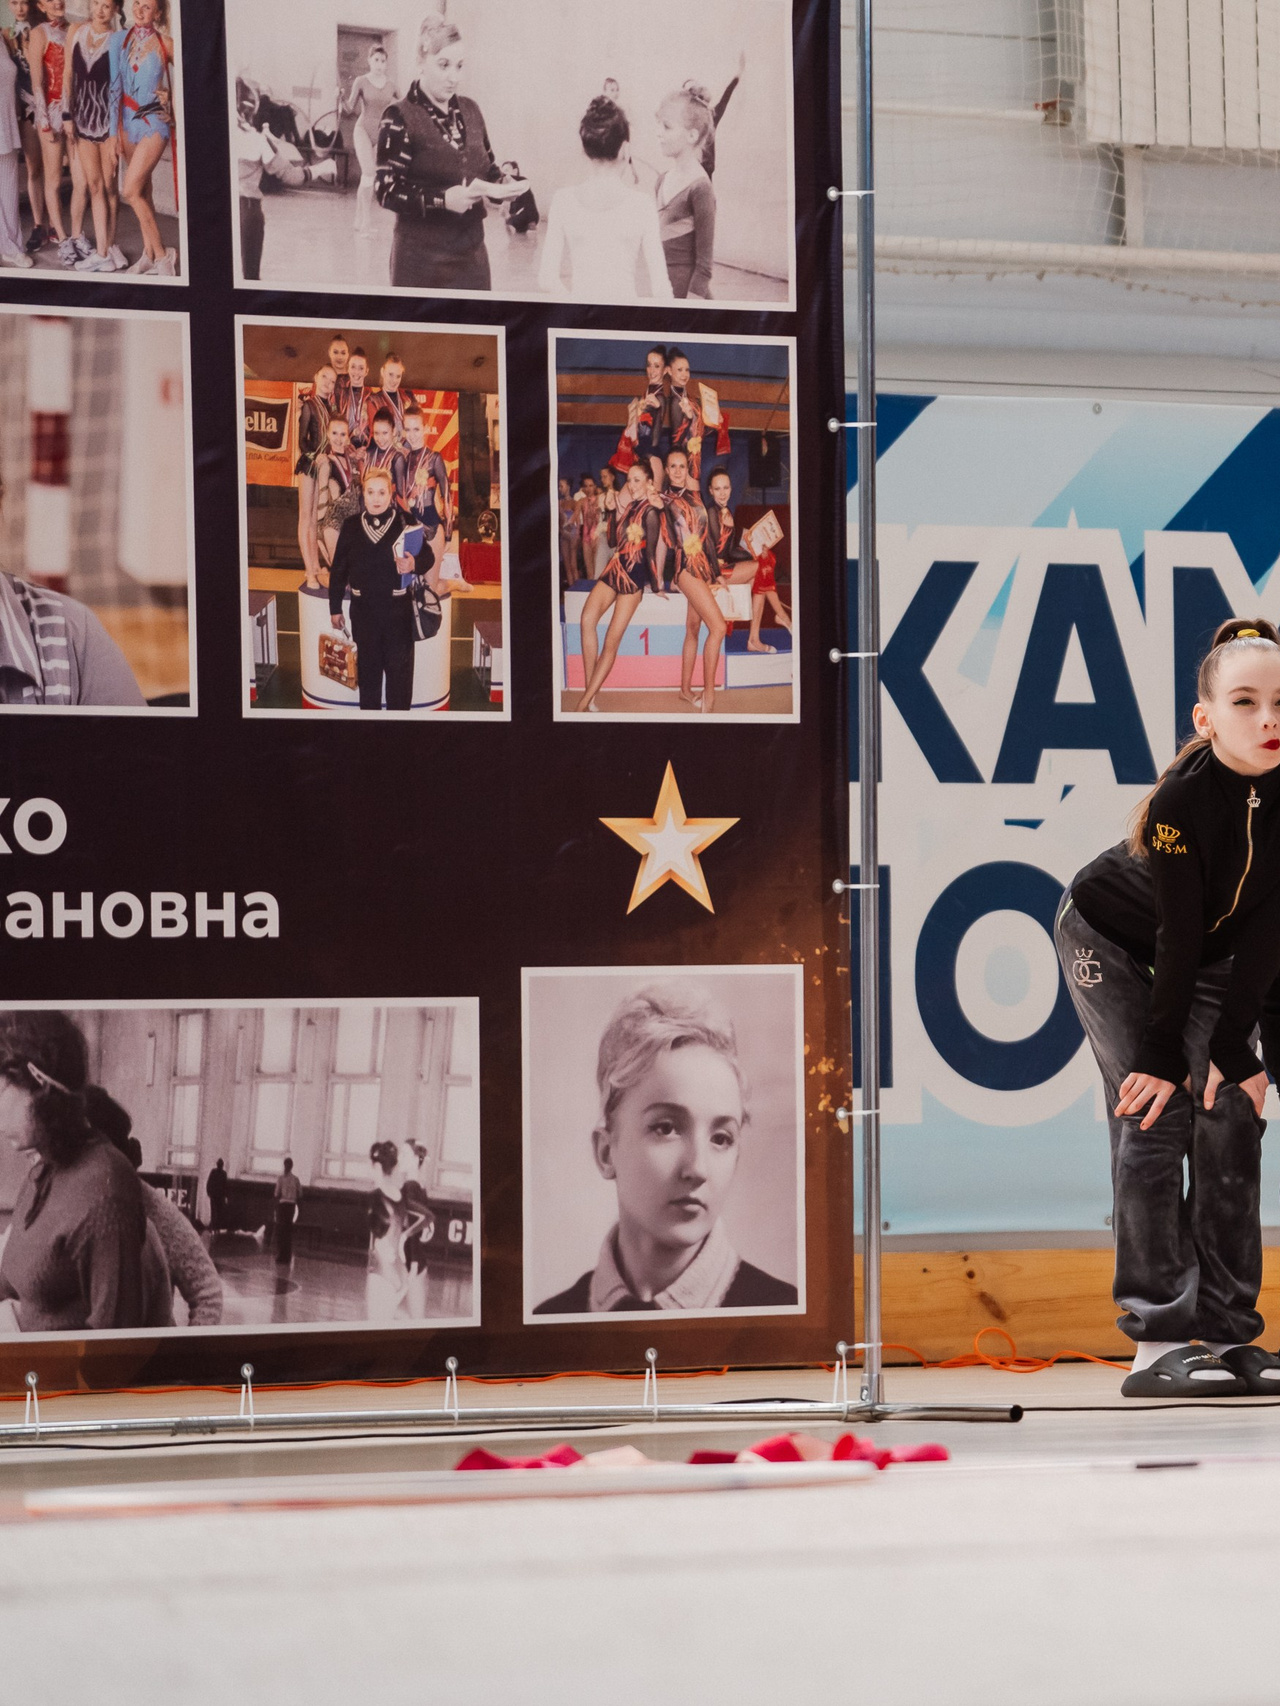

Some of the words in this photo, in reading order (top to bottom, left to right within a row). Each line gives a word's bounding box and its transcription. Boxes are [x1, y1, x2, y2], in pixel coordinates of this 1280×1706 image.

[245, 411, 278, 433] ella
[639, 627, 649, 656] 1
[0, 890, 280, 938] ановна
